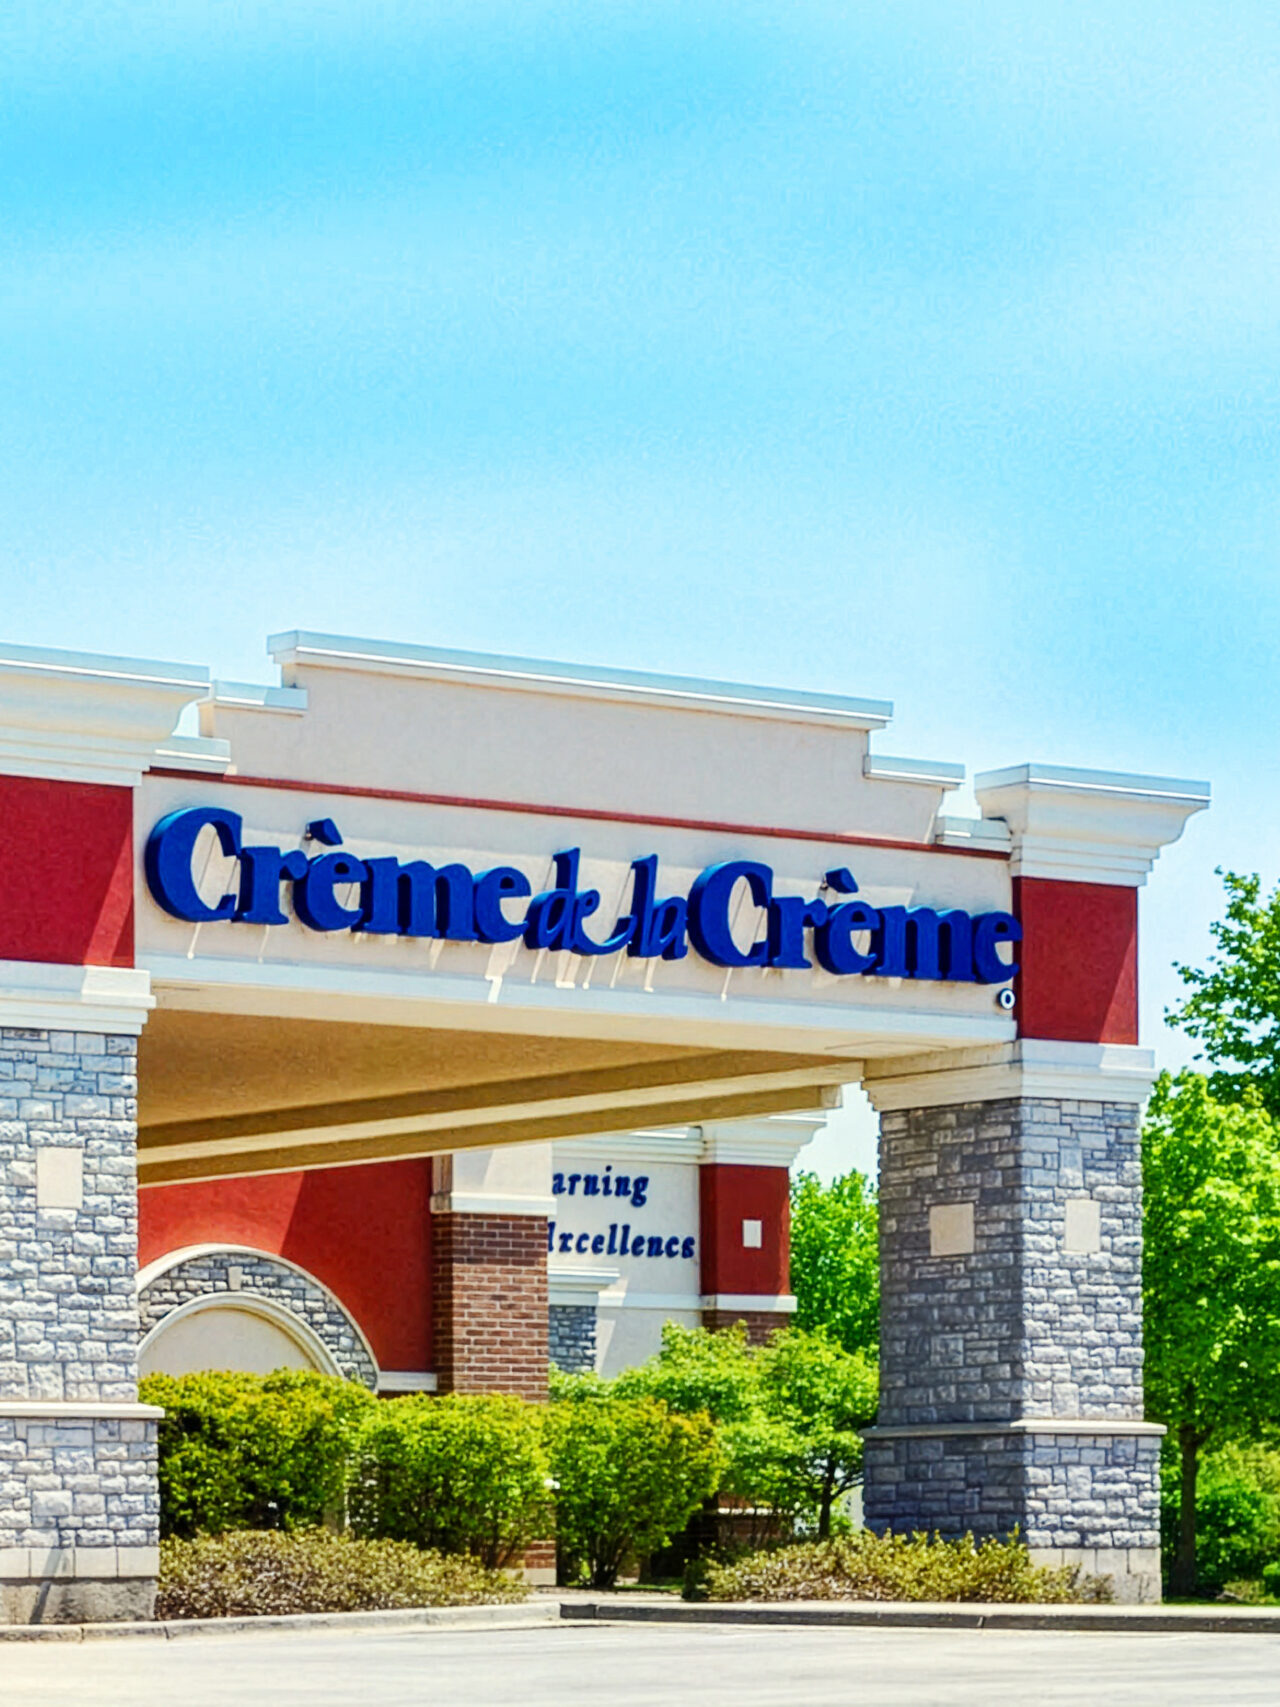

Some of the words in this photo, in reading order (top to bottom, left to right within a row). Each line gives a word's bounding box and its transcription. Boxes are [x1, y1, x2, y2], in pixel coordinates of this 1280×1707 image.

[145, 806, 531, 945] Crème
[523, 847, 635, 956] de
[627, 854, 688, 960] la
[687, 861, 1022, 985] Crème
